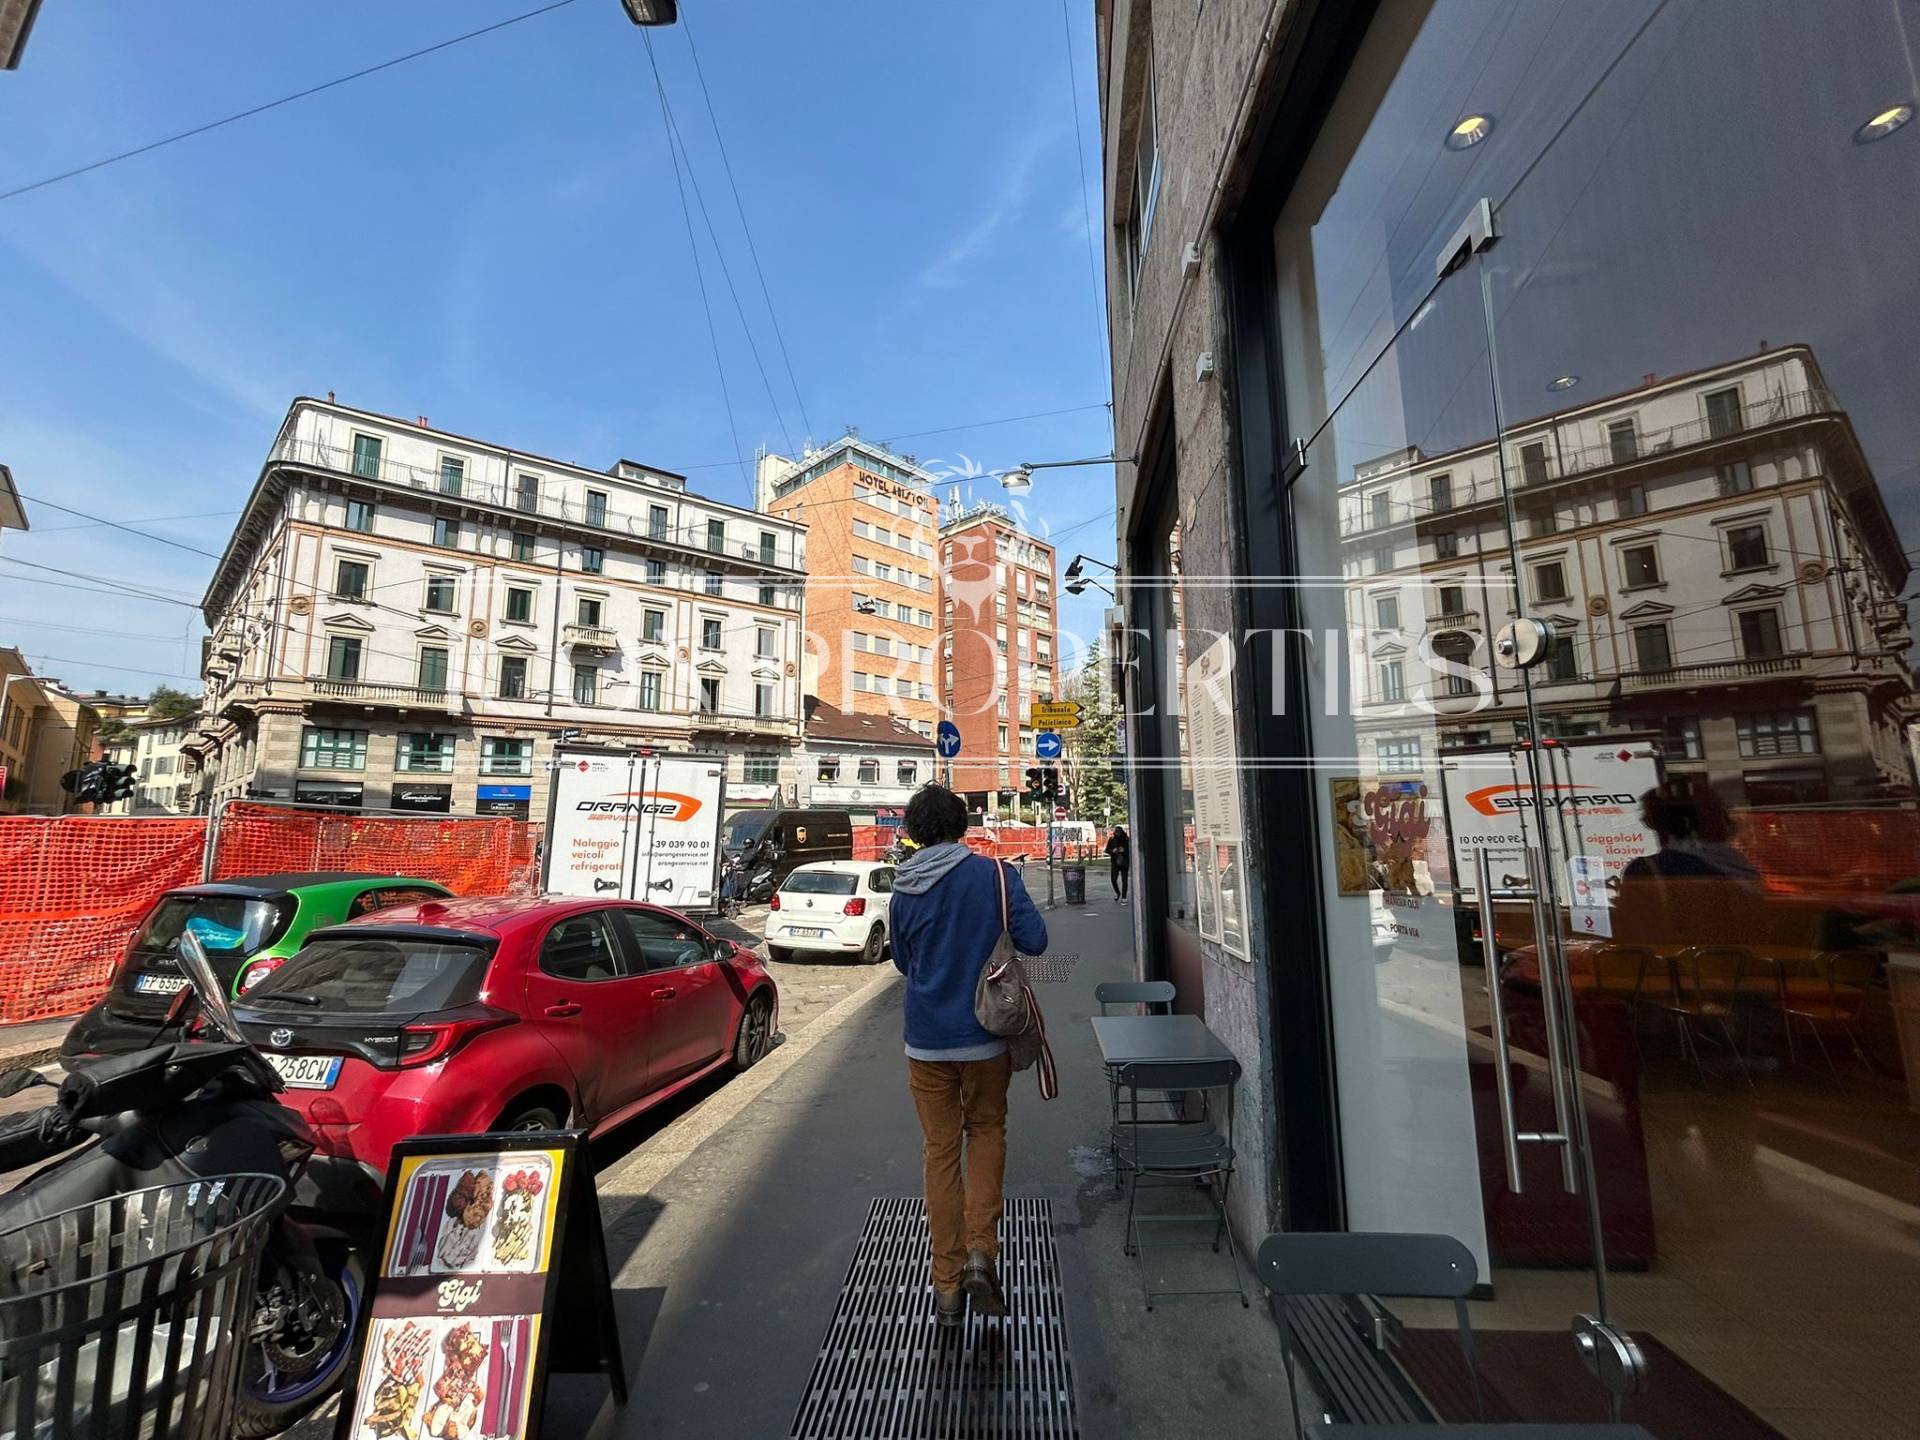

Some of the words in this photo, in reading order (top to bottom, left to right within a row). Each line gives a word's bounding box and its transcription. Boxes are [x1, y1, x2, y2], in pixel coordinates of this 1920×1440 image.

[859, 470, 890, 493] HOTEL
[1041, 705, 1071, 714] Tribunale
[1037, 717, 1072, 727] Policlinico
[575, 801, 678, 815] ORANGE
[587, 813, 640, 823] SERVICE
[572, 838, 620, 850] Noleggio
[668, 841, 685, 849] 039
[687, 841, 699, 849] 90
[700, 841, 710, 849] 01
[571, 850, 605, 859] veicoli
[570, 861, 624, 873] refrigerati
[1389, 923, 1409, 936] PORTA
[1408, 927, 1421, 938] VIA
[437, 1278, 483, 1312] Gigi
